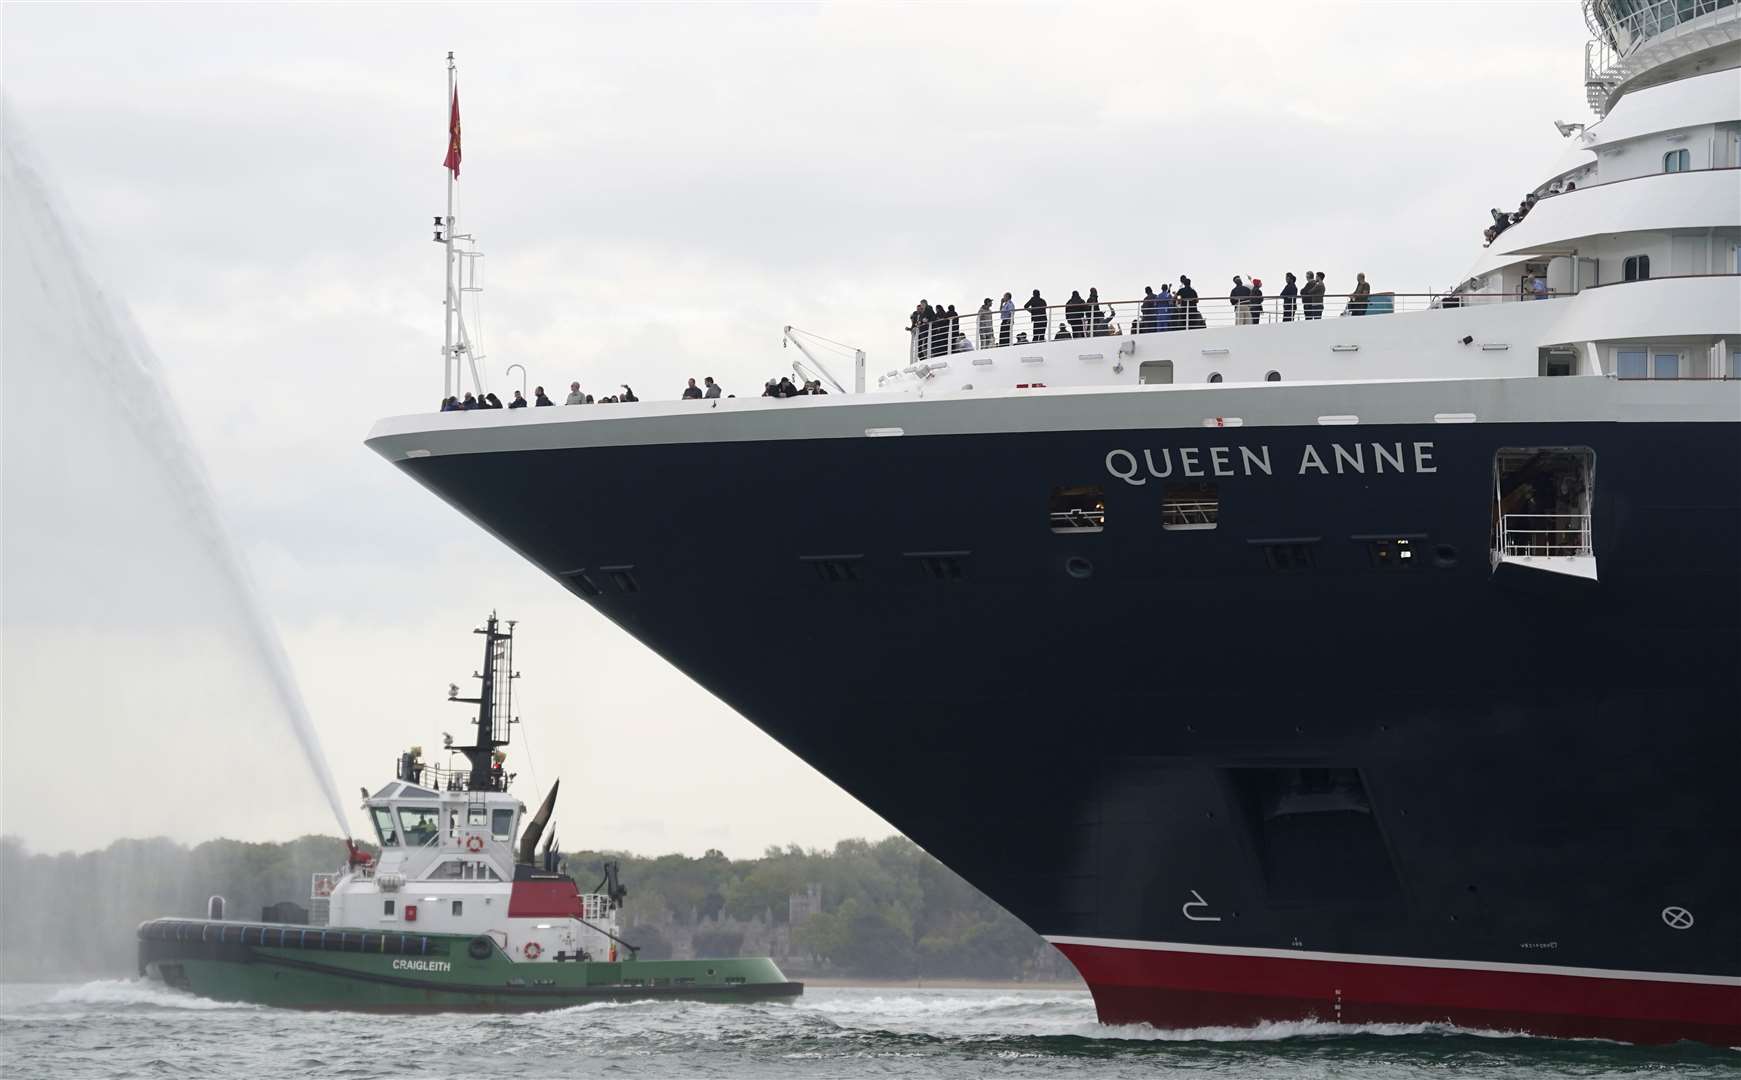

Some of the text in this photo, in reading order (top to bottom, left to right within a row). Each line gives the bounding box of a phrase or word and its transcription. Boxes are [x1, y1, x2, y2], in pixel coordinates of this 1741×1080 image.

[1105, 441, 1438, 486] QUEEN ANNE
[392, 959, 452, 972] CRAIGLEITH
